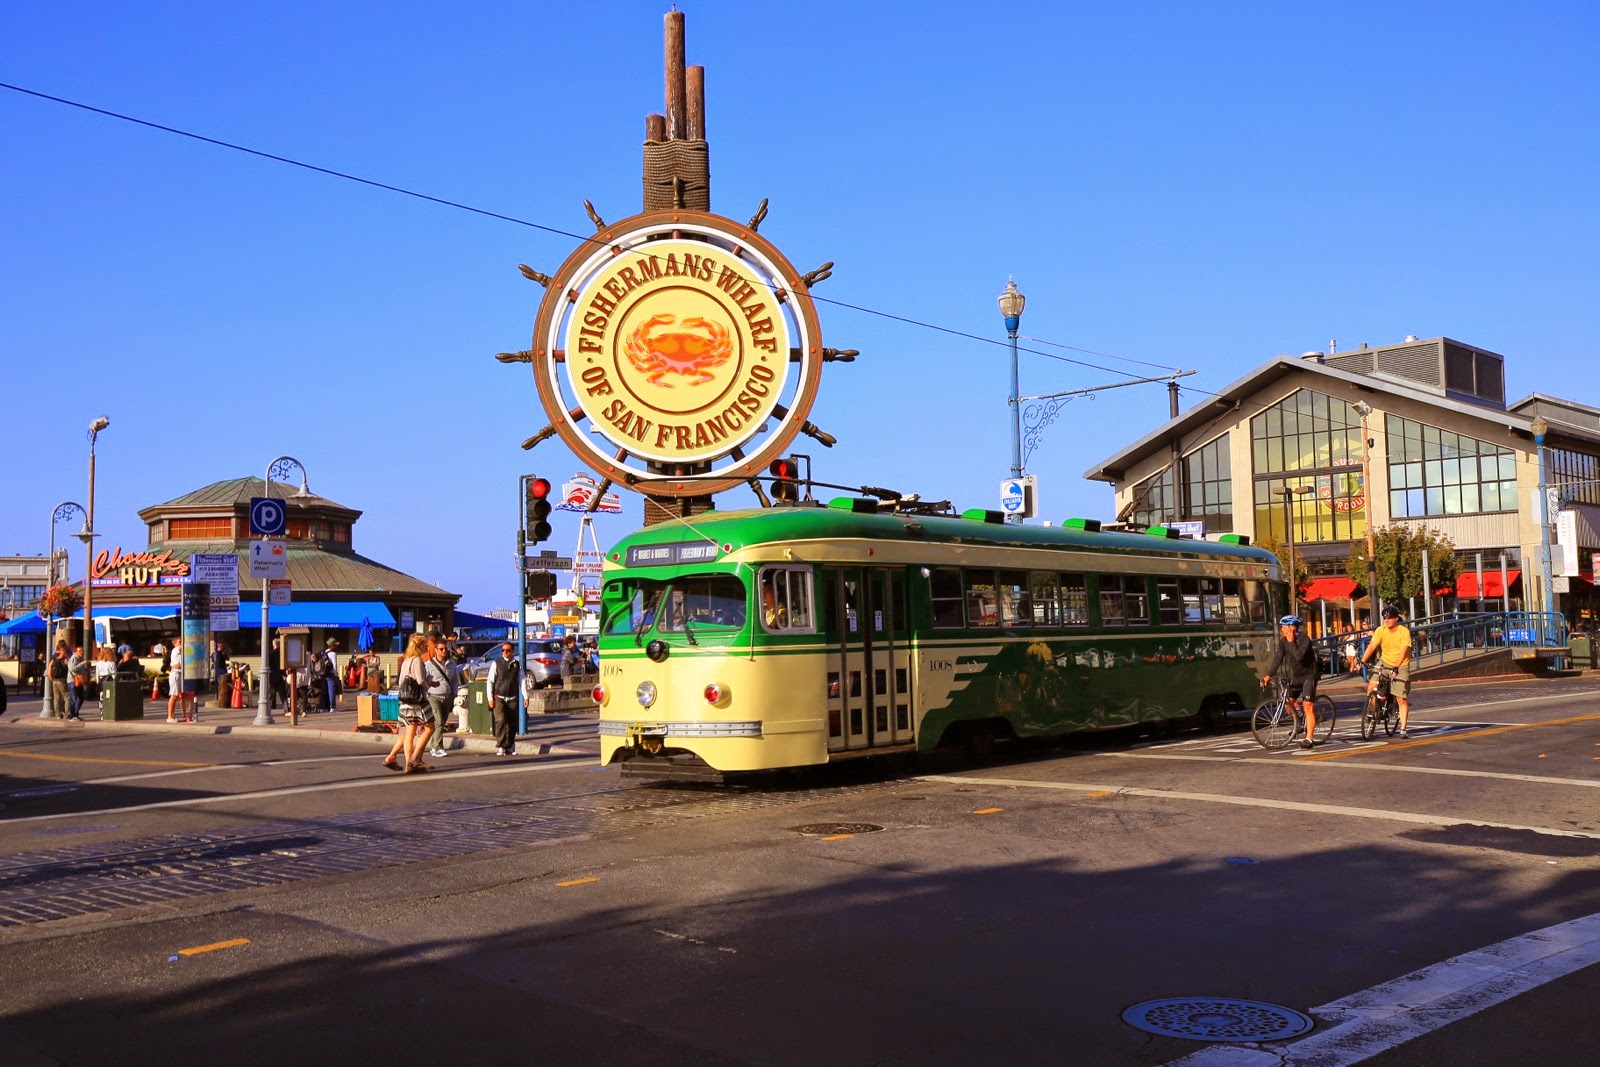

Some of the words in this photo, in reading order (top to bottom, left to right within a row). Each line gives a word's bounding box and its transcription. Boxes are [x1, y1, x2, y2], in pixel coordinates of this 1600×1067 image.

[578, 252, 717, 355] FISHERMANS
[716, 264, 778, 354] WHARF
[581, 365, 614, 397] OF
[601, 399, 653, 442] SAN
[654, 364, 775, 450] FRANCISCO
[1322, 490, 1365, 510] SORDOU
[92, 547, 189, 578] Chowder
[633, 549, 637, 562] F
[705, 546, 717, 557] WHAR
[531, 559, 569, 567] Jefferson
[121, 567, 161, 584] HUT
[603, 664, 624, 677] 1008
[930, 660, 953, 671] 1008
